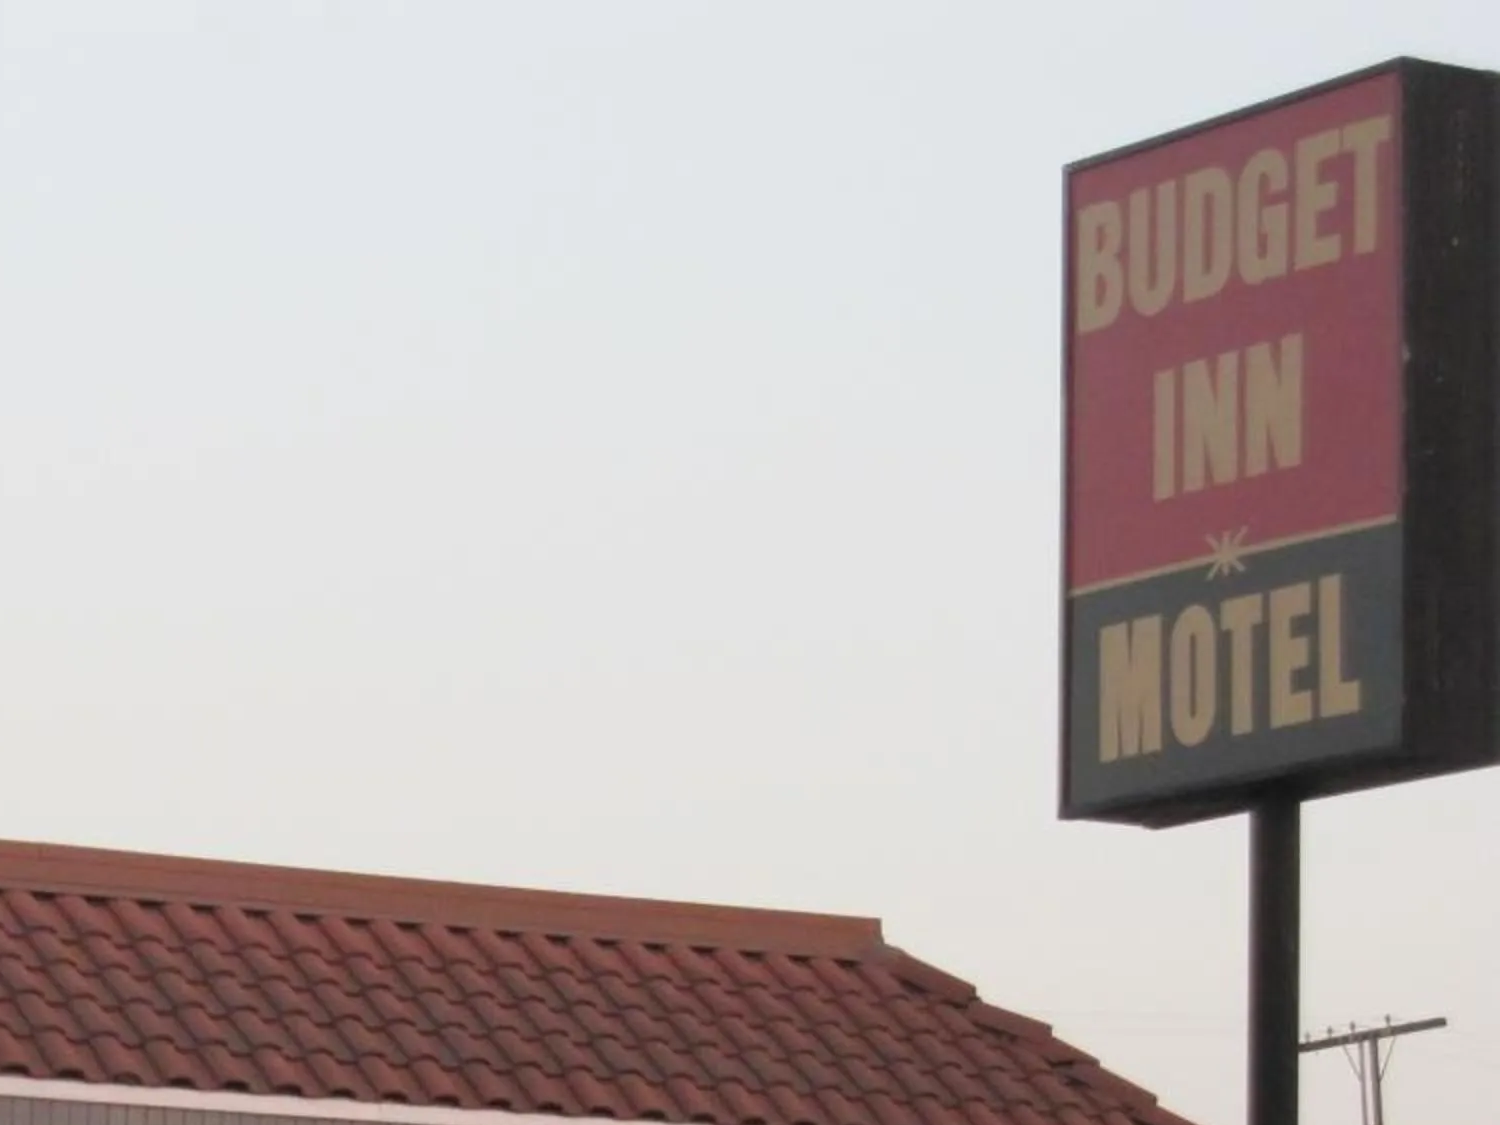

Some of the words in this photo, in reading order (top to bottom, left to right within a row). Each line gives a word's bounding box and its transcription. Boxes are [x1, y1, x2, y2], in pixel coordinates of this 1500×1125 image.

[1076, 114, 1392, 334] BUDGET
[1153, 332, 1303, 502] INN
[1100, 573, 1361, 763] MOTEL
